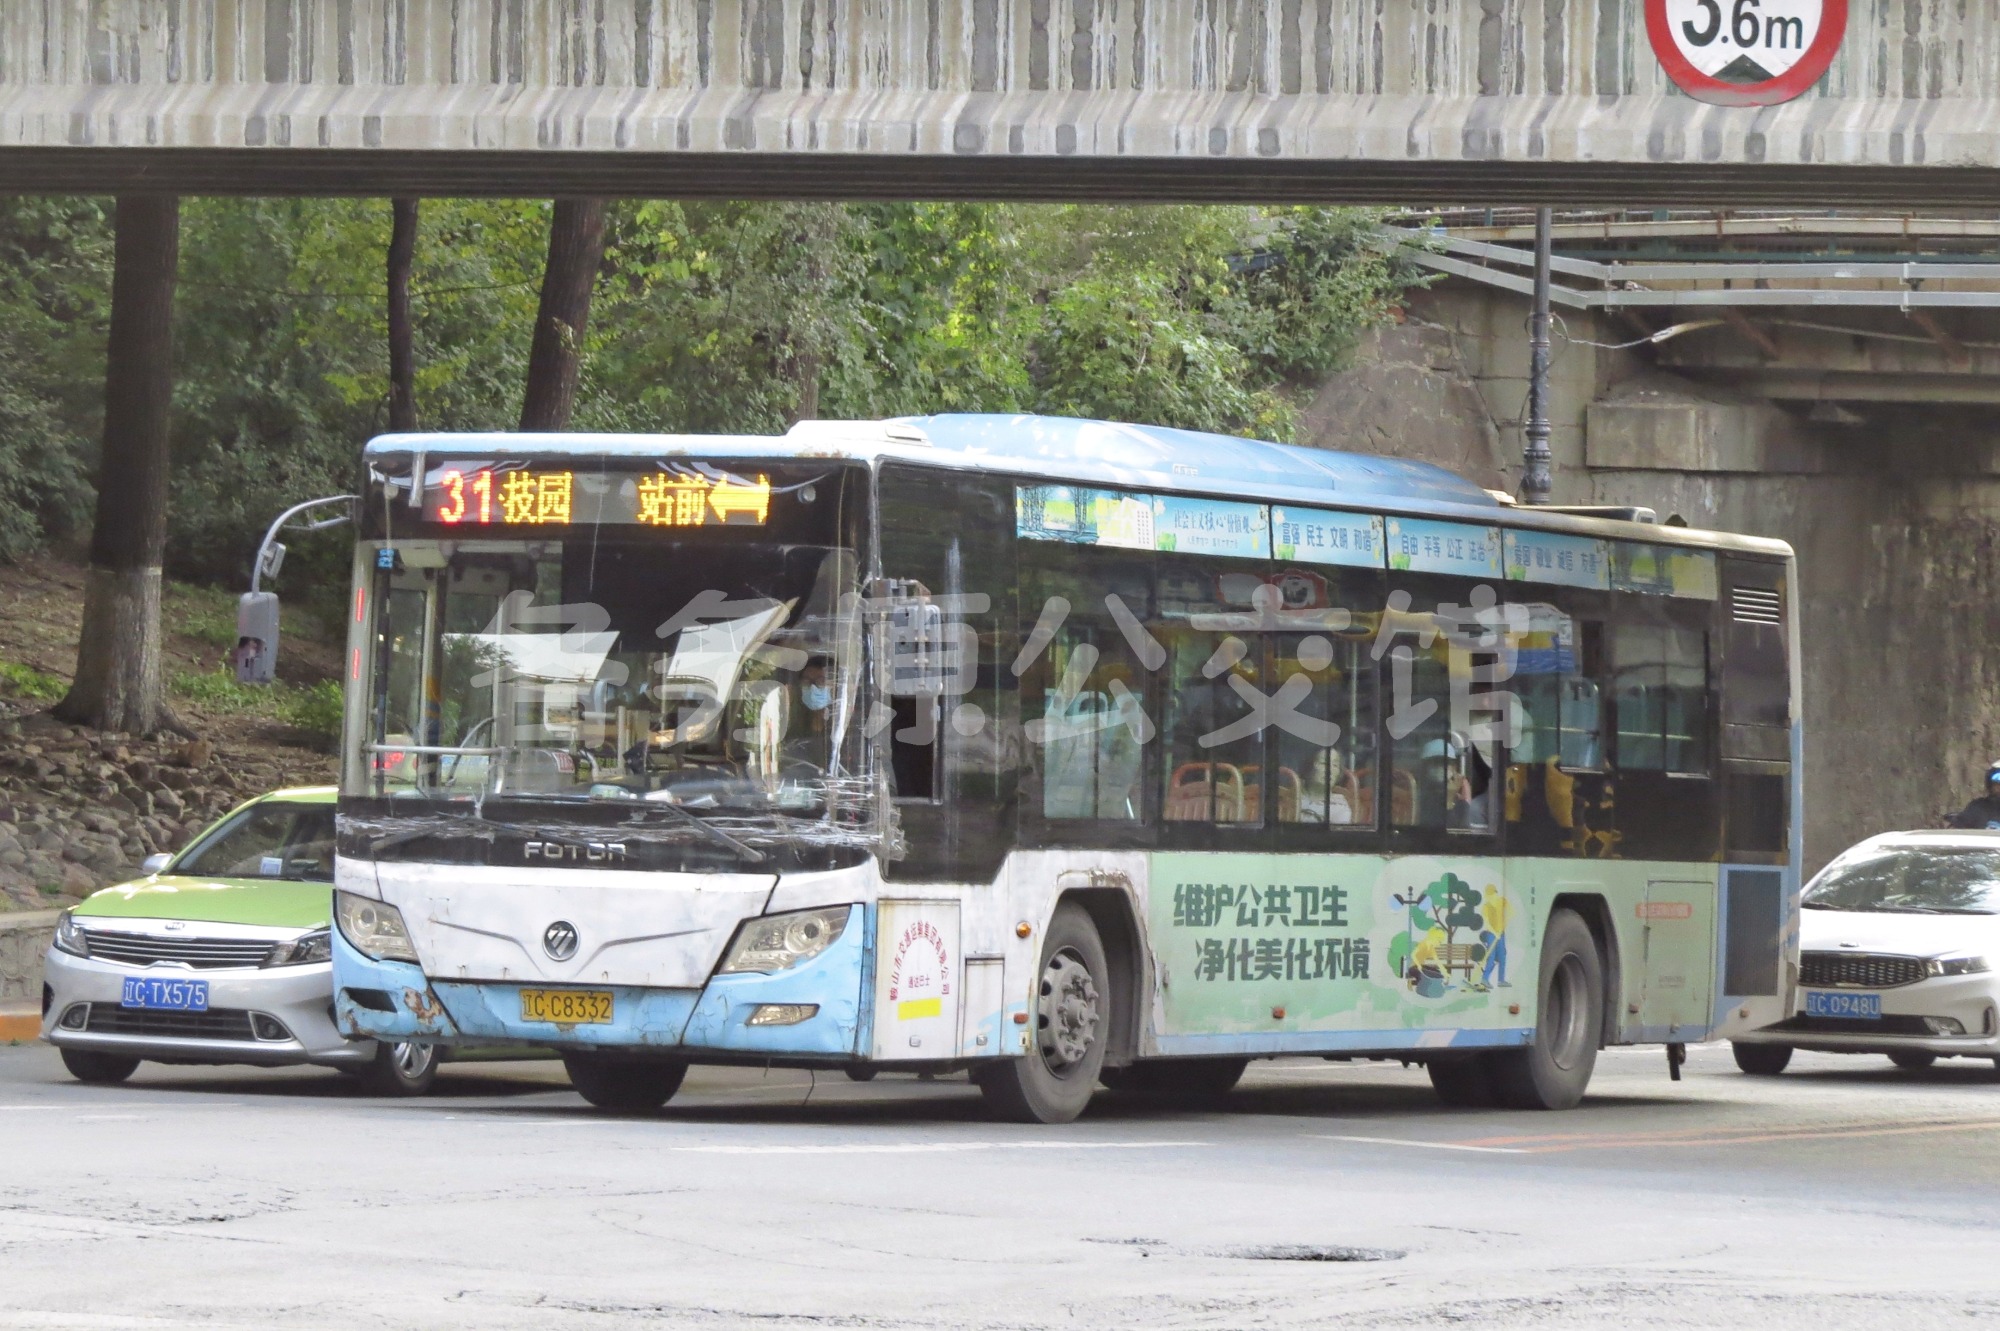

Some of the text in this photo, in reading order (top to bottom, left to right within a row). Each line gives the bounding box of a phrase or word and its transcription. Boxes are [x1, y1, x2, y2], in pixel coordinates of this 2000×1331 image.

[440, 470, 492, 523] 31
[637, 472, 710, 525] 站前
[1173, 883, 1348, 927] 维护公共卫生
[1194, 937, 1371, 982] 净化美化环境
